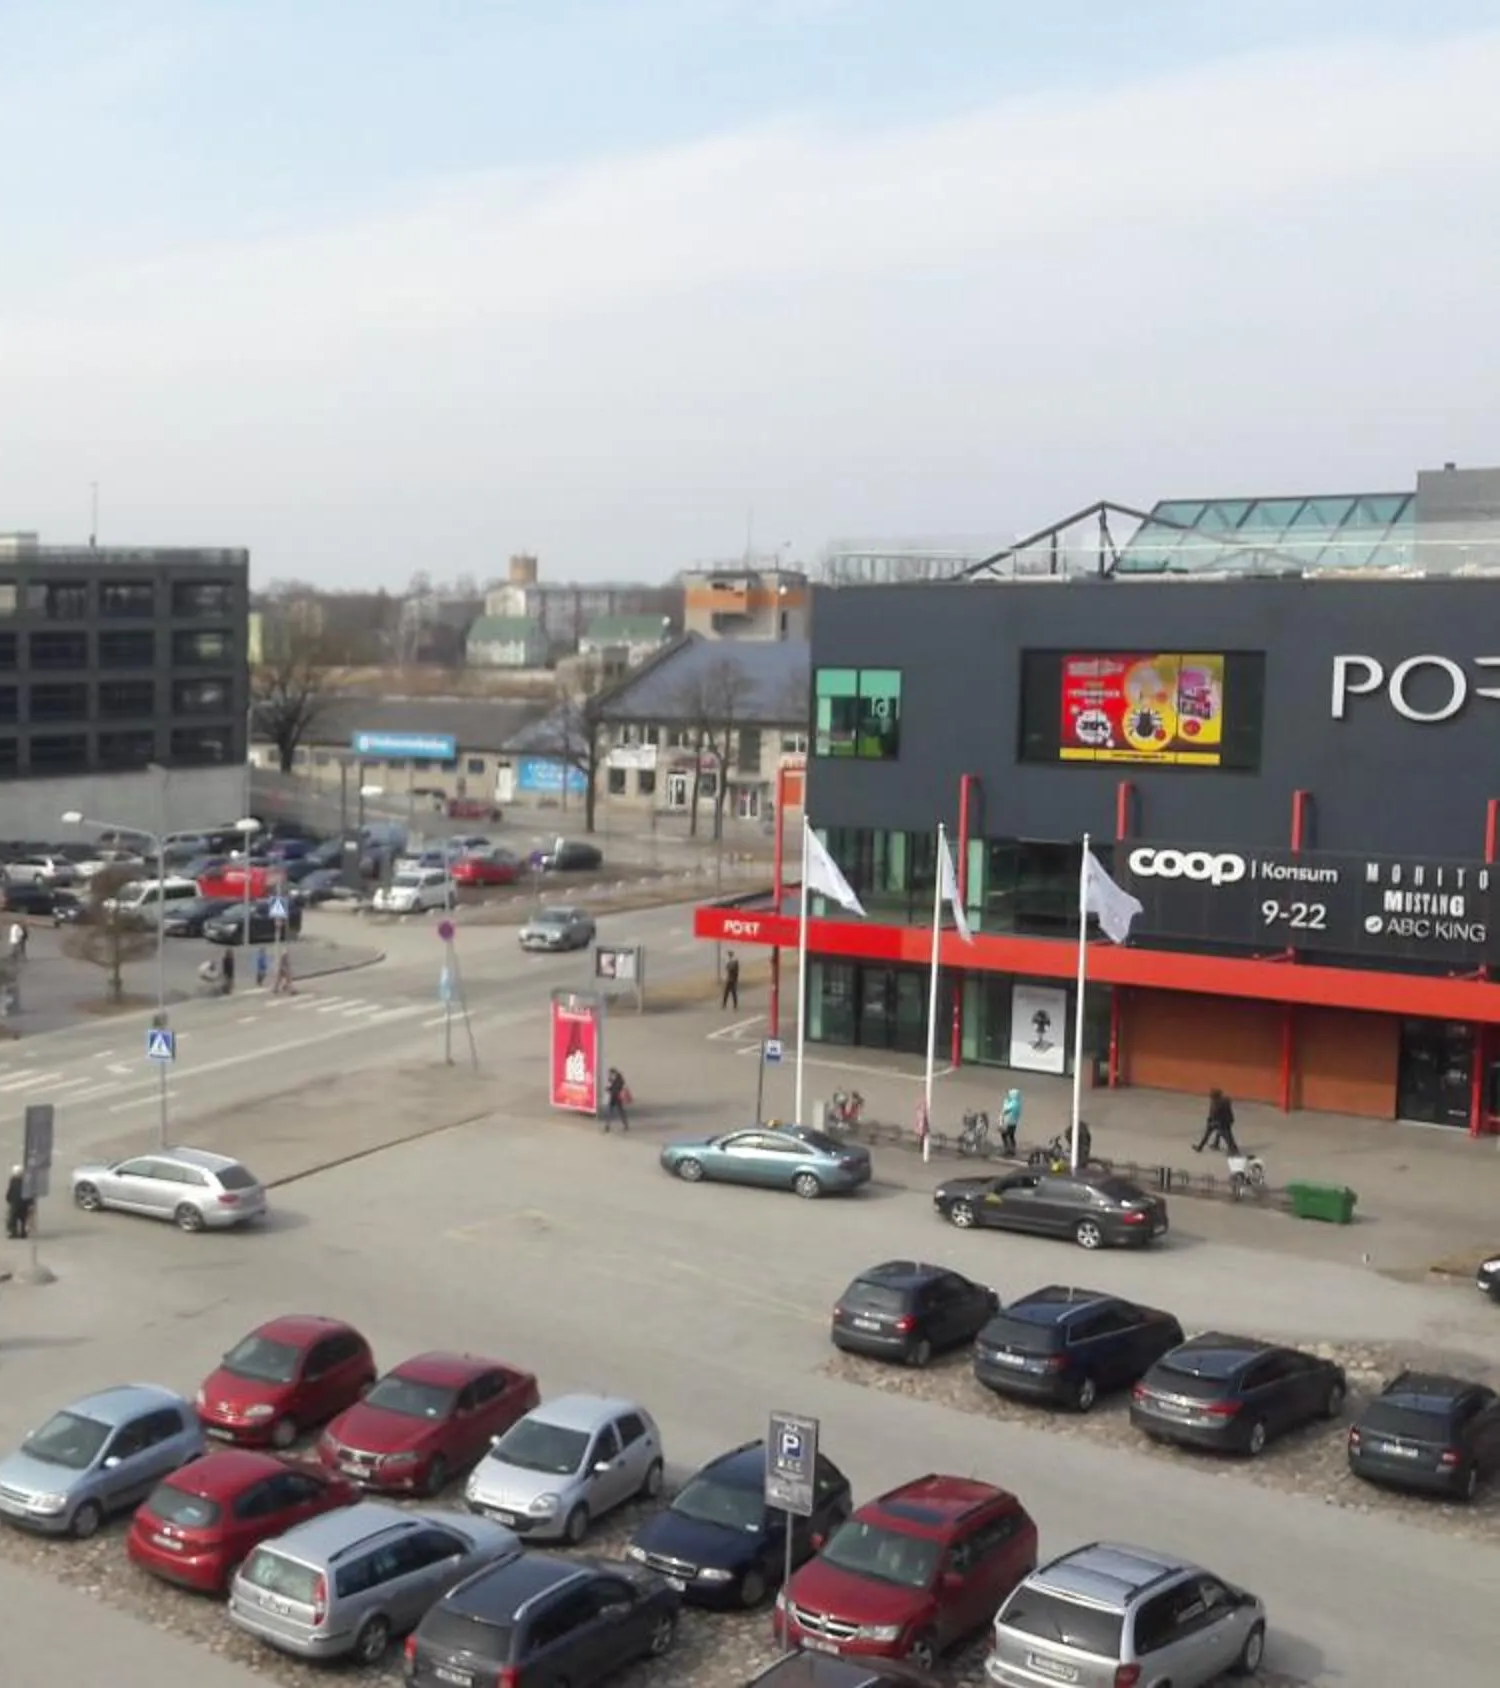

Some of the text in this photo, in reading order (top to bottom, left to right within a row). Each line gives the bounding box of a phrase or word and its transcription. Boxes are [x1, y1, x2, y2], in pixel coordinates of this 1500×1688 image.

[1129, 847, 1338, 886] coop Konsum
[1261, 900, 1327, 930] 9-22
[1384, 889, 1465, 917] MUSTANG
[1386, 917, 1487, 942] ABC KING
[782, 1432, 801, 1454] P
